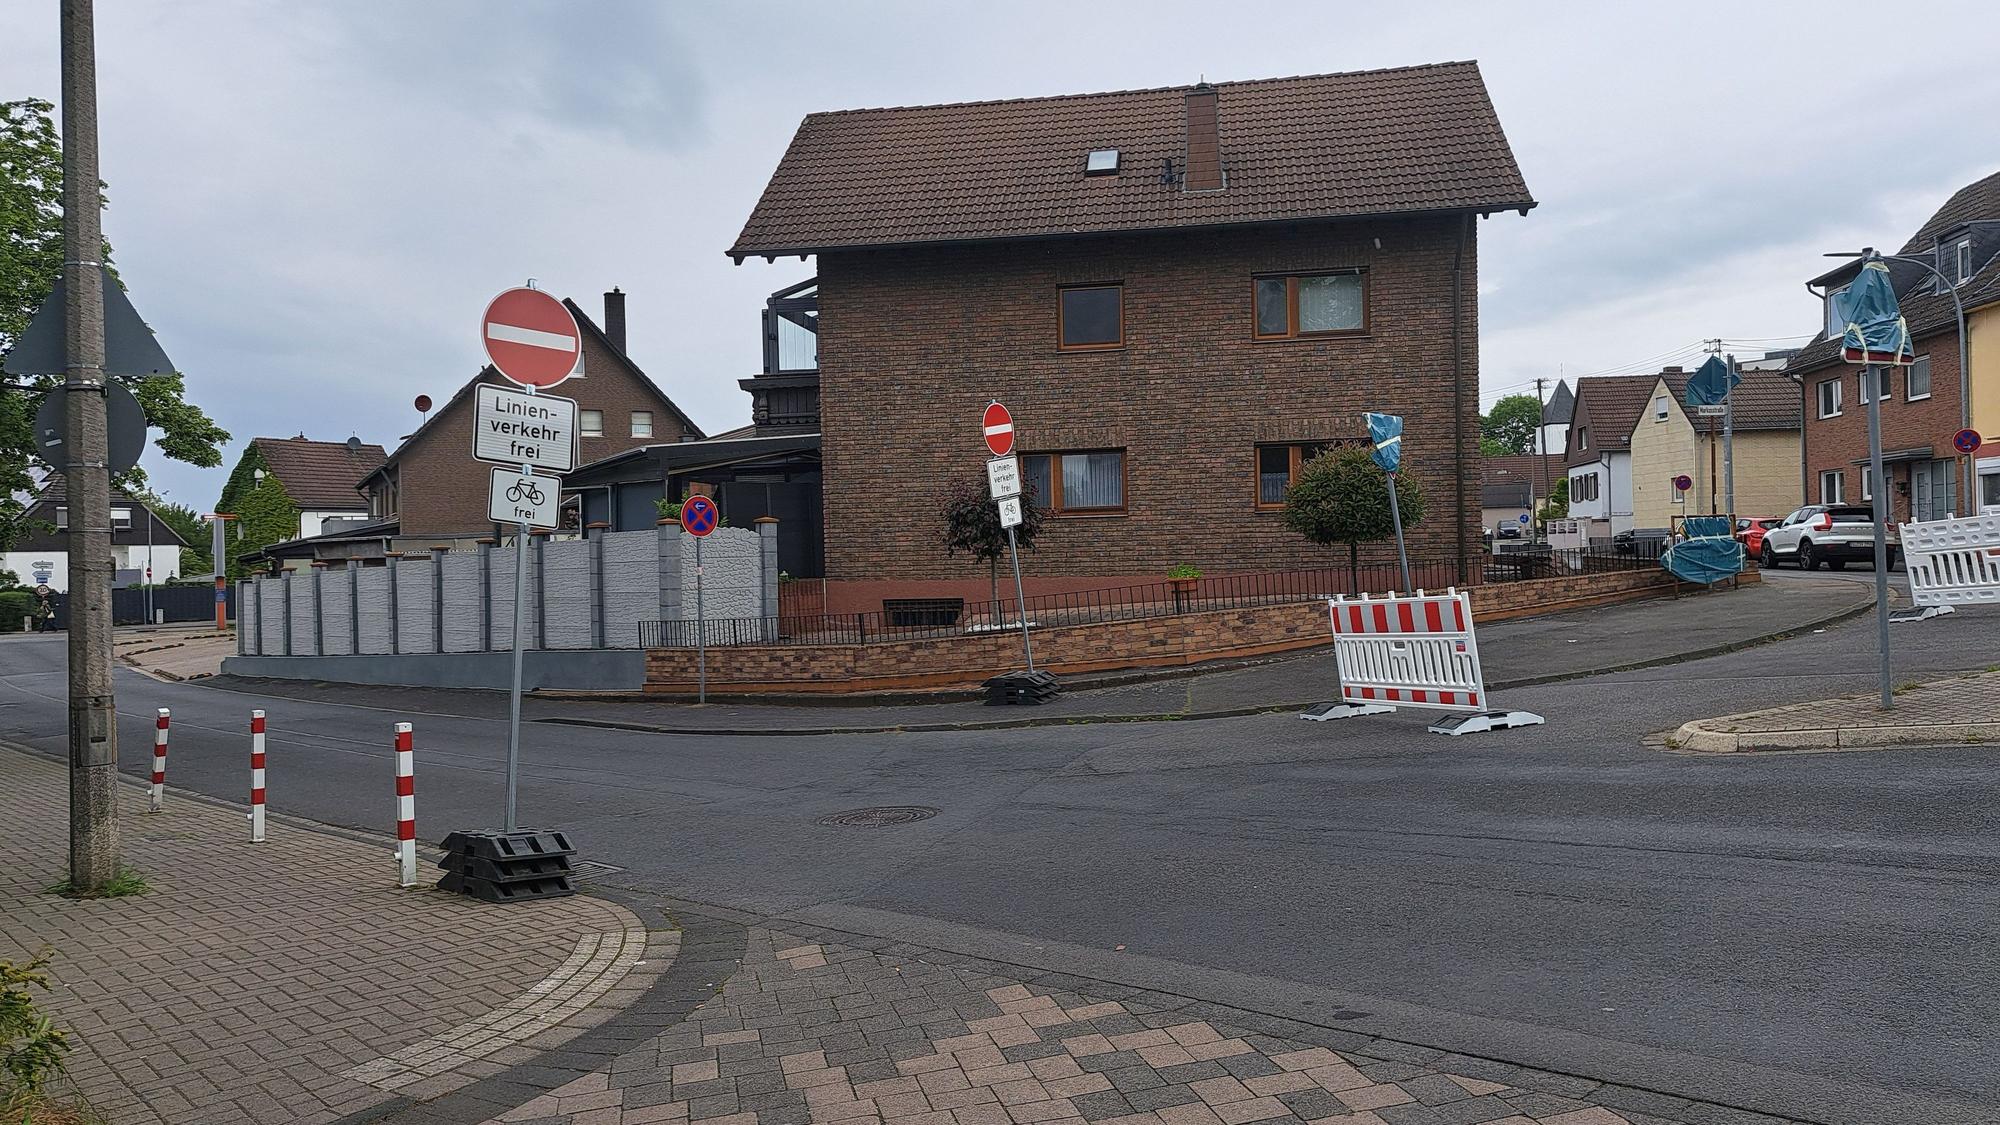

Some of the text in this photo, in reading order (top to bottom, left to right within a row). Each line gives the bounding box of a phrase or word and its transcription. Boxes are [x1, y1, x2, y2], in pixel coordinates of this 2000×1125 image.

[495, 396, 558, 420] Linien-
[490, 420, 561, 441] verkehr
[510, 441, 540, 459] frei
[992, 463, 1013, 473] Linien-
[993, 473, 1015, 483] verkehr
[1001, 483, 1012, 493] frei
[514, 506, 536, 519] frei
